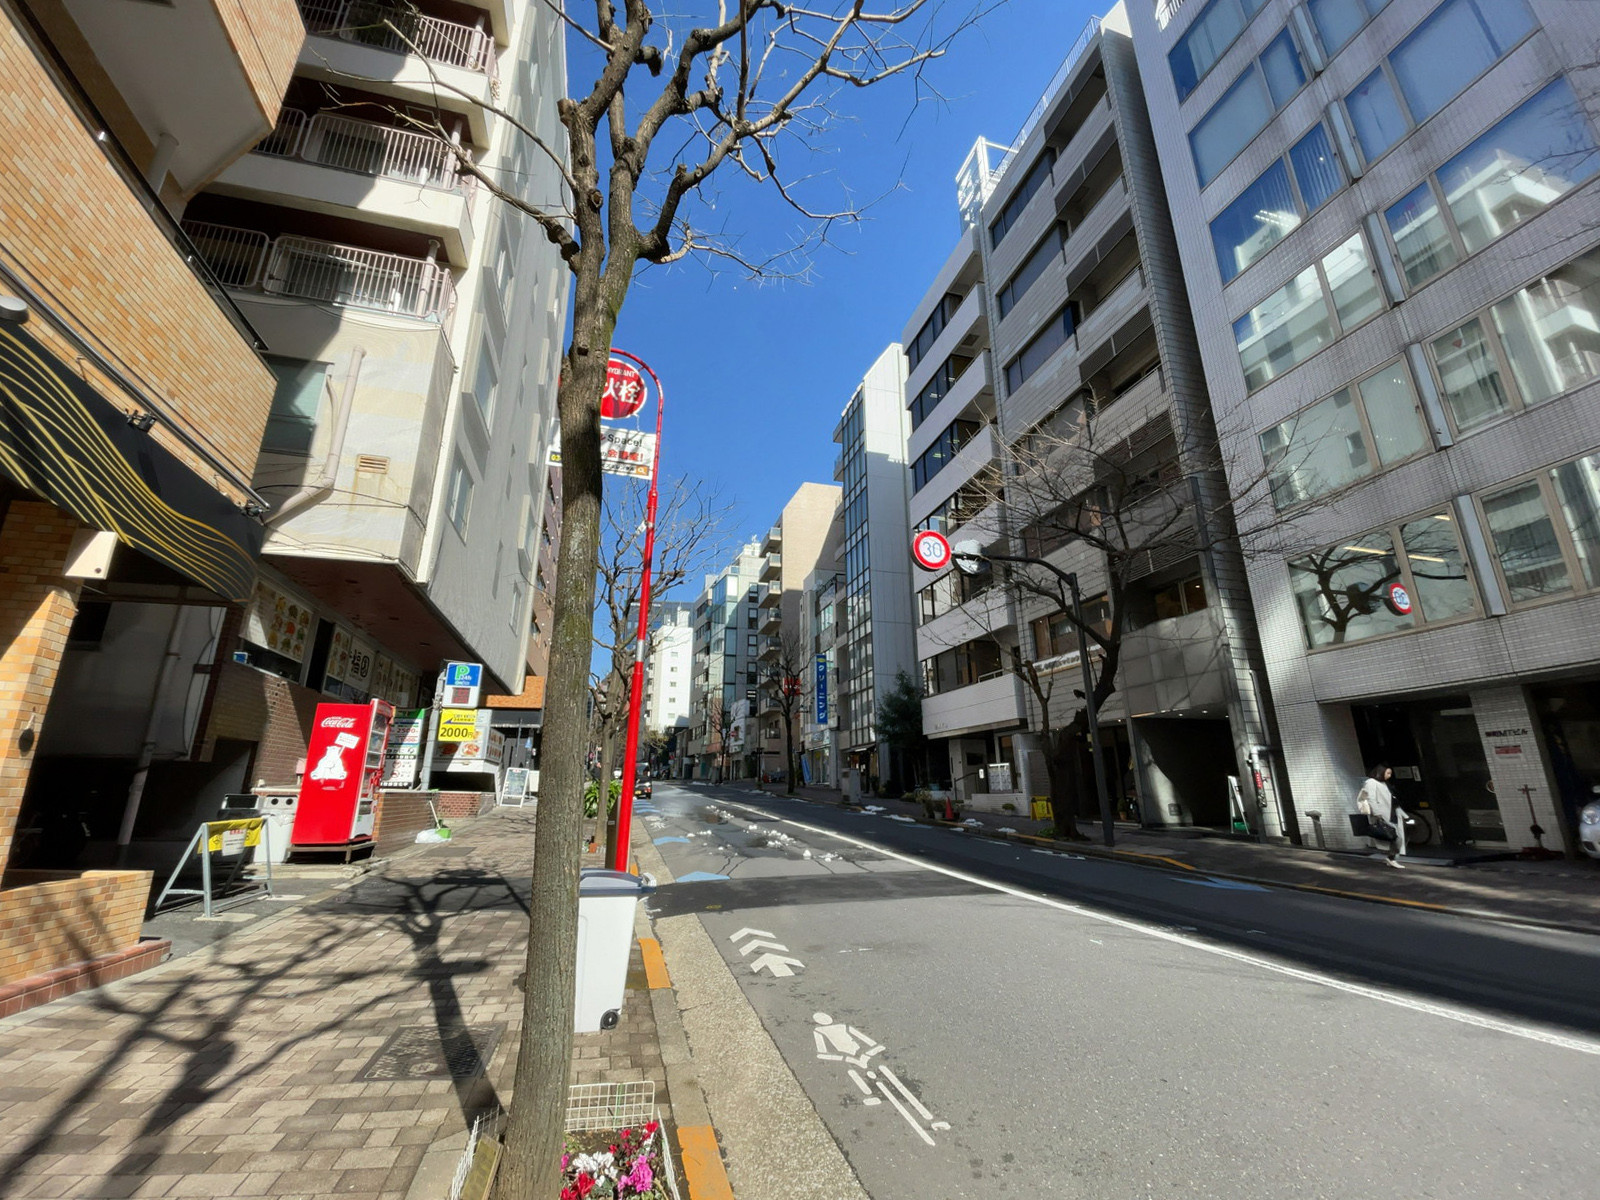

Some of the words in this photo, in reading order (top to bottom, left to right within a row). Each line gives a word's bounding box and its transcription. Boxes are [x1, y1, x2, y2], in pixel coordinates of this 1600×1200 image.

[922, 541, 943, 559] 30
[455, 665, 471, 681] P
[817, 663, 827, 720] クリーニング
